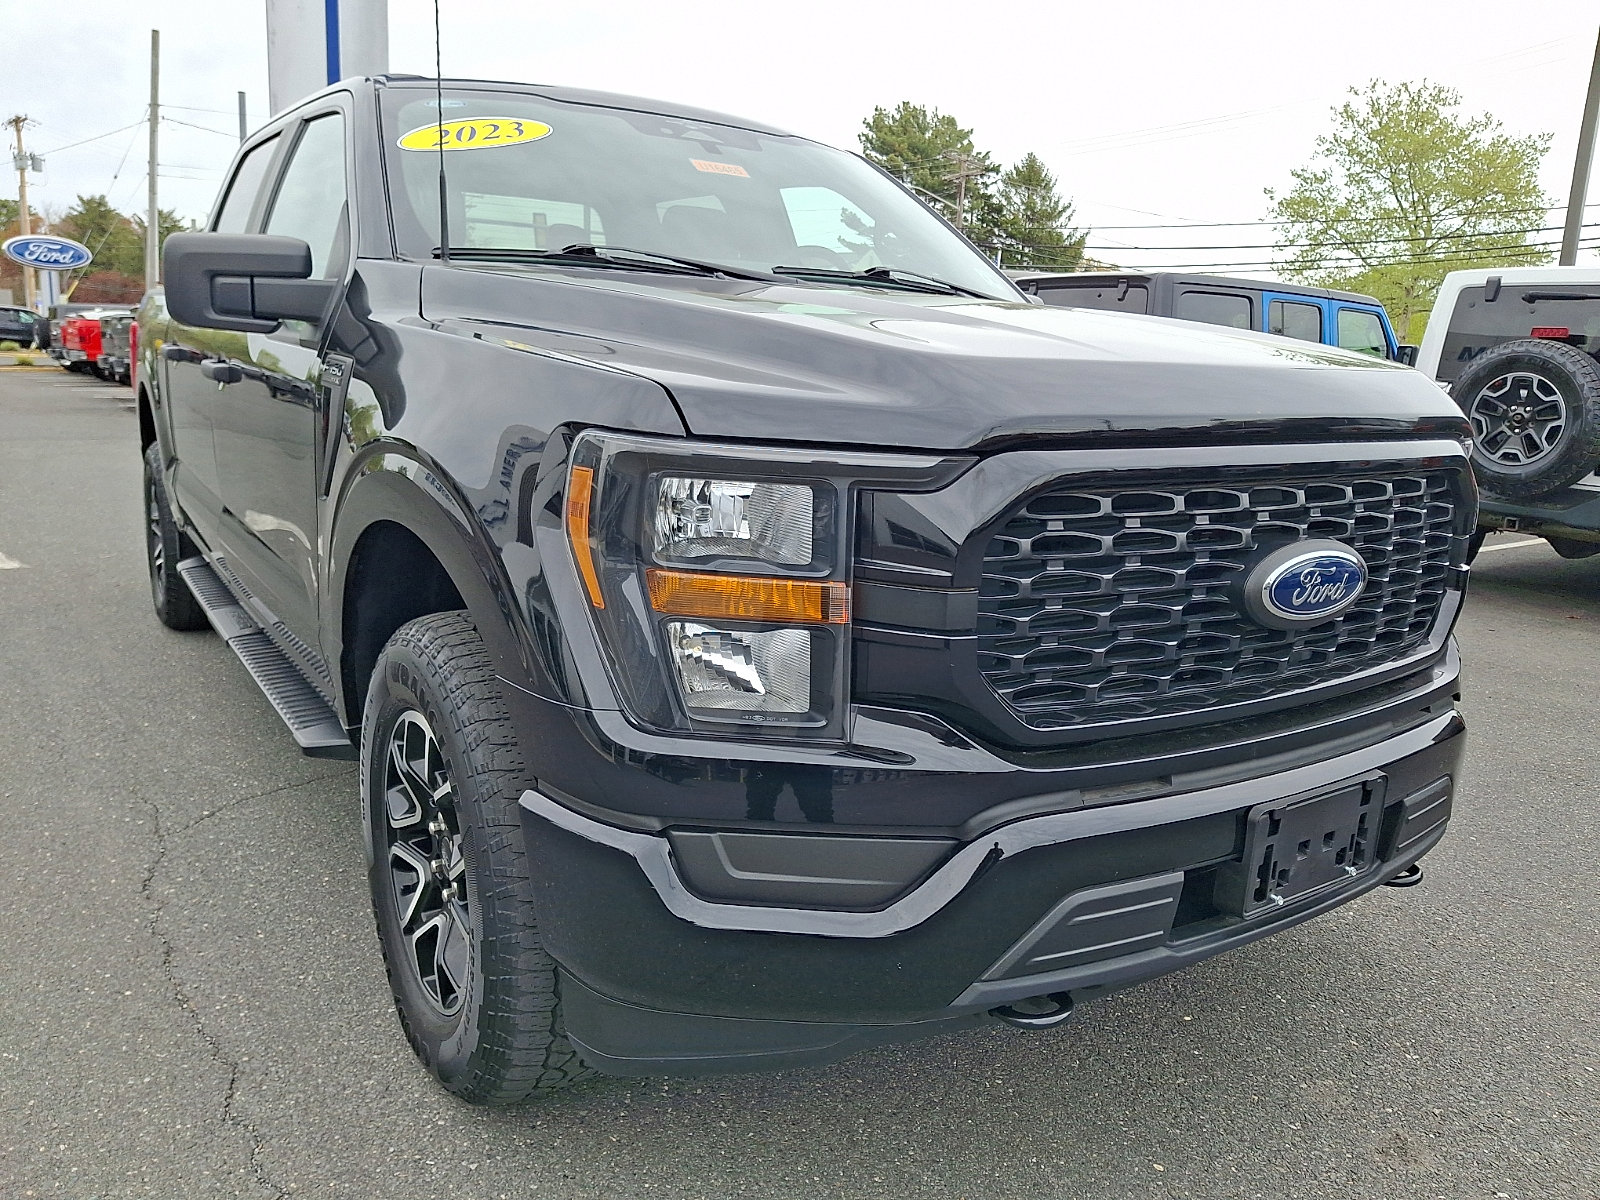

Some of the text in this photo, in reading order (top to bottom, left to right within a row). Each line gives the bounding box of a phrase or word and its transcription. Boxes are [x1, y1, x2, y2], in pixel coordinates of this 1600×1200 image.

[431, 121, 524, 147] 2023
[24, 242, 75, 264] Ford
[1292, 566, 1349, 607] Ford
